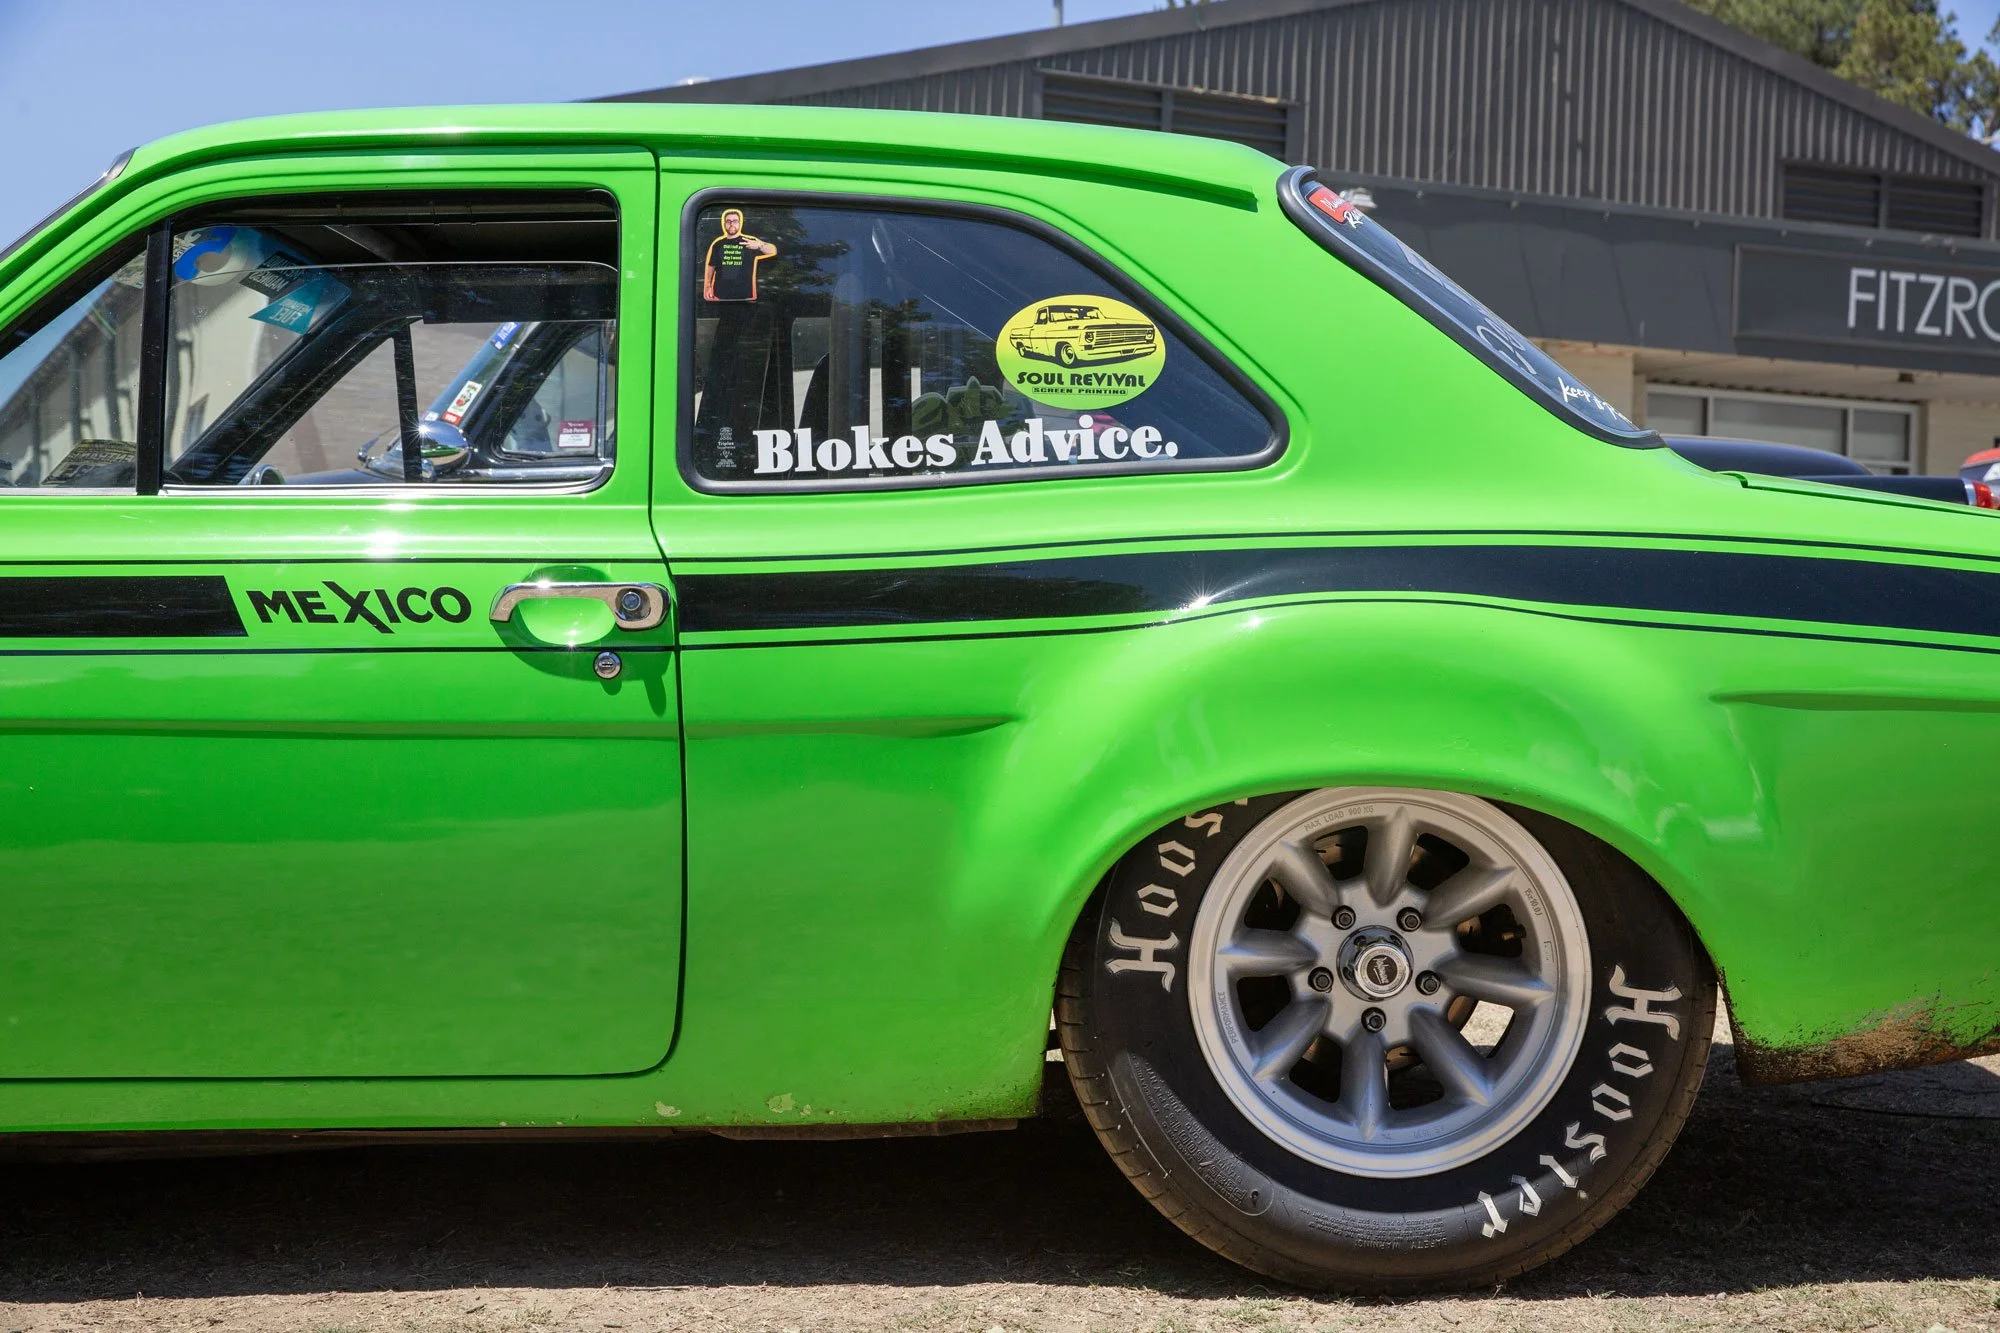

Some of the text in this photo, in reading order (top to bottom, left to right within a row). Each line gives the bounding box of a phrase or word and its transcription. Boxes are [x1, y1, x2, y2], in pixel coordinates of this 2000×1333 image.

[1017, 372, 1065, 386] SOUL
[752, 414, 1180, 474] Blokes Advice.
[245, 580, 472, 635] MEXICO
[1304, 819, 1322, 832] MAX
[1324, 810, 1344, 823] LOAD
[1218, 991, 1239, 1045] PERFORMANCE
[1477, 964, 1683, 1238] Hoosier
